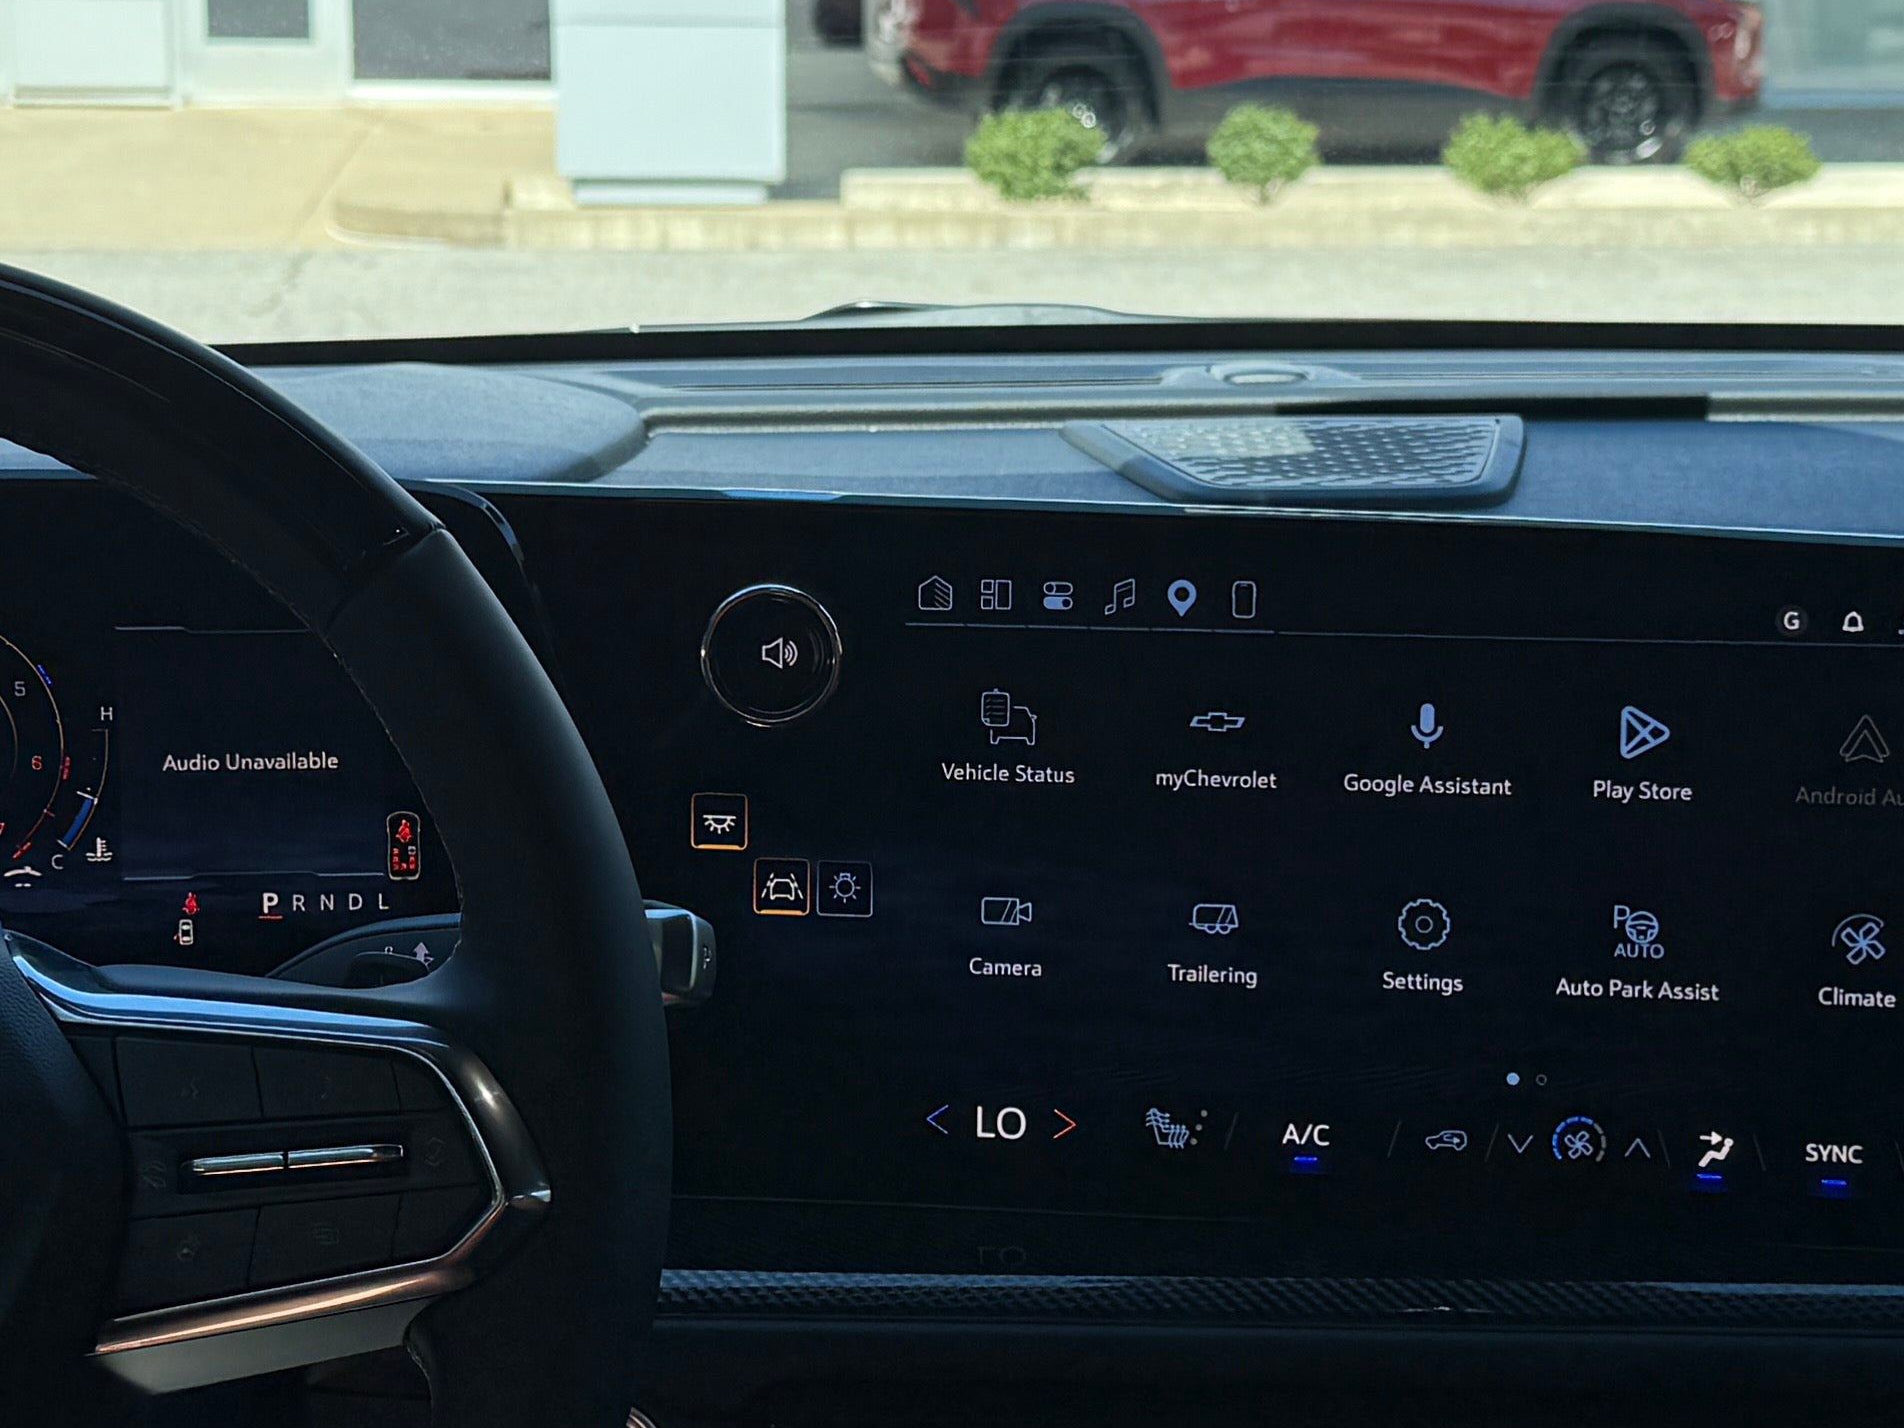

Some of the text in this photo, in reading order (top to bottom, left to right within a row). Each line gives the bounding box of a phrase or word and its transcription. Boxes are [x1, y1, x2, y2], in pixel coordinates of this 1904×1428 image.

[13, 682, 27, 697] 5
[100, 707, 113, 721] H
[31, 755, 44, 771] 6
[162, 751, 340, 772] Audio Unavailable
[941, 762, 1075, 784] Vehicle Status
[1155, 768, 1277, 792] myChevrolet
[1343, 773, 1512, 798] Google Assistant
[1593, 779, 1693, 804] Play Store
[1795, 785, 1876, 806] Android
[51, 854, 64, 870] C
[262, 892, 390, 914] P R N D L
[1613, 943, 1665, 959] AUTO
[969, 957, 1042, 977] Camera
[1167, 963, 1258, 989] Trailering
[1382, 971, 1464, 997] Settings
[1555, 977, 1720, 1001] Auto Park Assist
[1818, 986, 1897, 1008] Climate
[976, 1105, 1027, 1140] LO
[1282, 1123, 1330, 1147] A/C
[1805, 1143, 1863, 1164] SYNC
